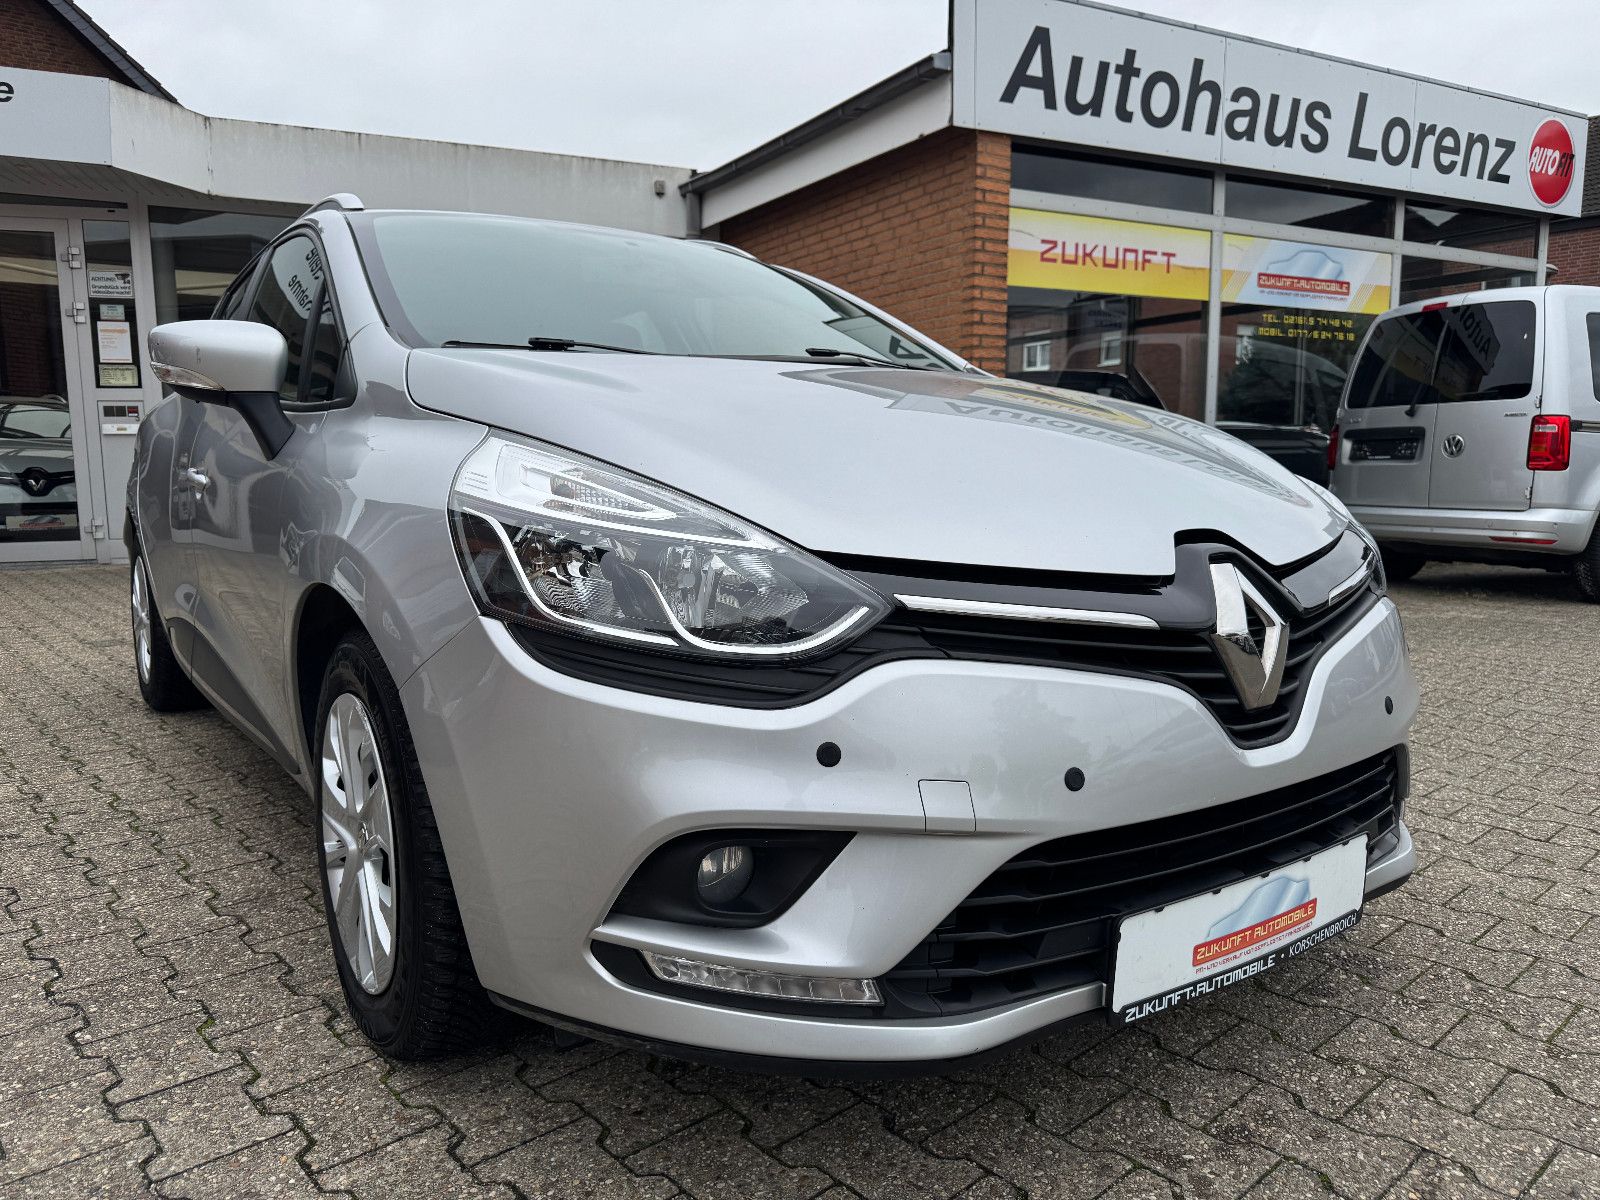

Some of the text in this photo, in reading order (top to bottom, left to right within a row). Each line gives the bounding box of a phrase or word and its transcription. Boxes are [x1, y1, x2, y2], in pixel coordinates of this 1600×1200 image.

[998, 25, 1516, 184] Autohaus Lorenz
[1040, 239, 1176, 274] ZUKUNFT
[1196, 903, 1314, 960] ZUKUNFT AUTOMOBILE
[1288, 912, 1358, 957] KORSCHENBROICH
